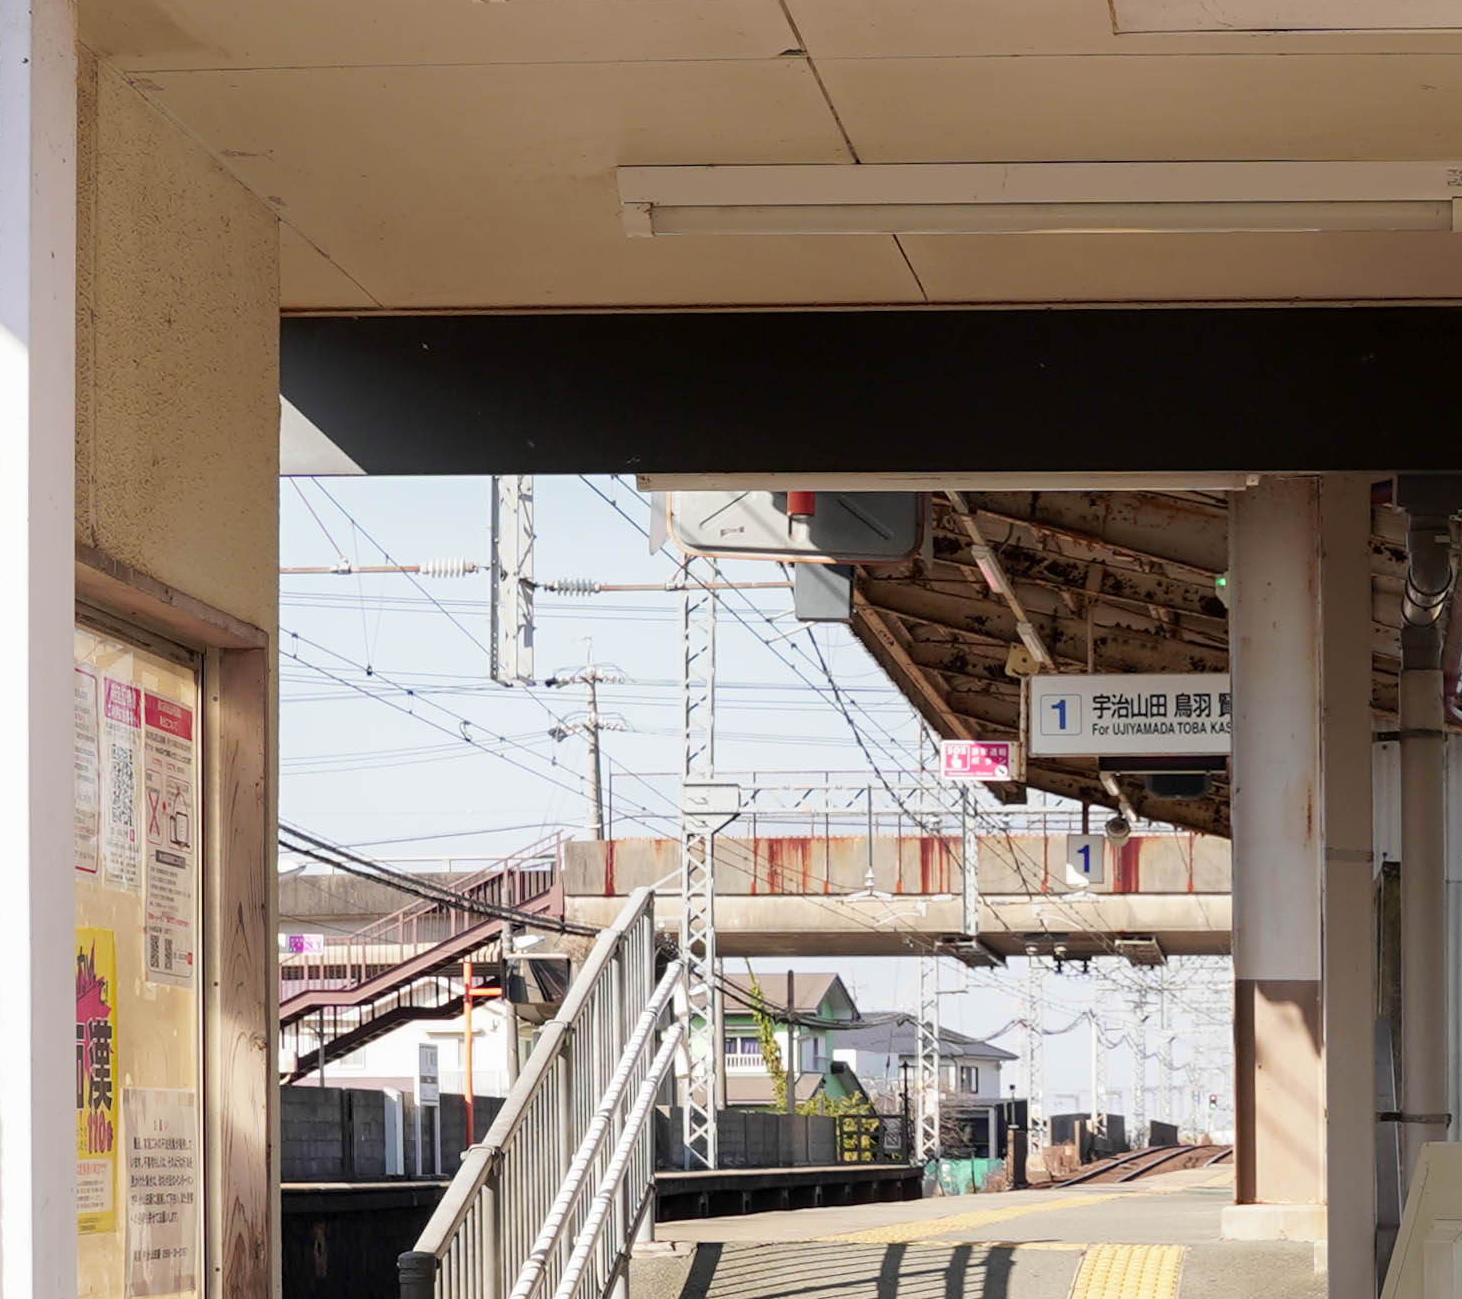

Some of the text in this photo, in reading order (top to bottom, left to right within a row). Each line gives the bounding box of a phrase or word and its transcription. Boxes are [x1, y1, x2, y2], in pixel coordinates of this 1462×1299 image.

[1051, 699, 1067, 730] 1
[1092, 693, 1168, 720] 宇治山田
[1174, 693, 1211, 719] 鳥羽
[1092, 723, 1109, 735] For
[1112, 722, 1175, 735] UJIYAMADA
[1177, 721, 1208, 735] TOBA
[1077, 844, 1090, 873] 1
